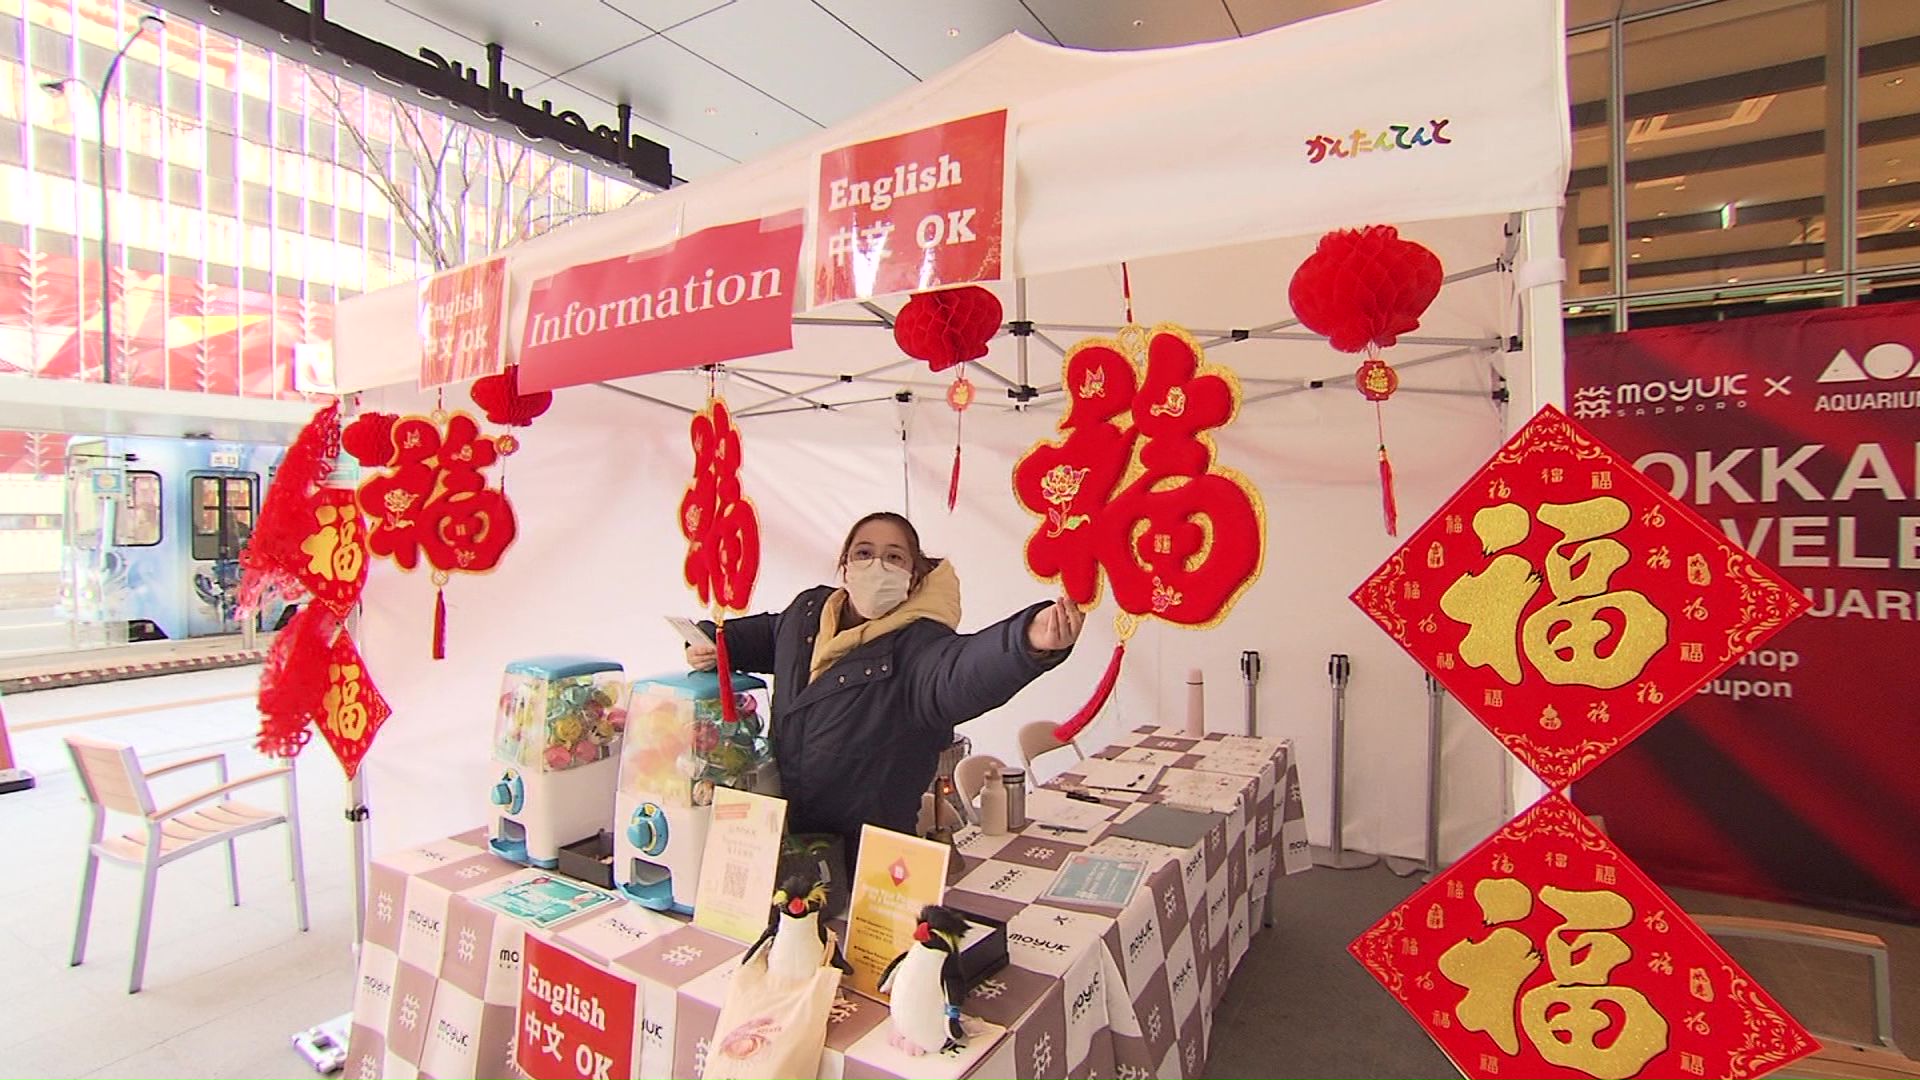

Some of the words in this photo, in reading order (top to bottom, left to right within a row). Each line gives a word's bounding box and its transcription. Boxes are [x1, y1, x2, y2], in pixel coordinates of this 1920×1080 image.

[1305, 119, 1452, 164] かんたんてんと
[828, 154, 962, 212] English
[916, 208, 977, 250] OK
[528, 266, 782, 348] Information
[1616, 400, 1747, 417] SAPPORO
[1815, 391, 1920, 412] AQUARIU
[1631, 442, 1920, 505] OKKA
[1438, 495, 1669, 690] 福
[527, 963, 606, 1032] English
[1437, 877, 1670, 1080] 福
[524, 1008, 566, 1063] 中文
[575, 1044, 614, 1080] OK
